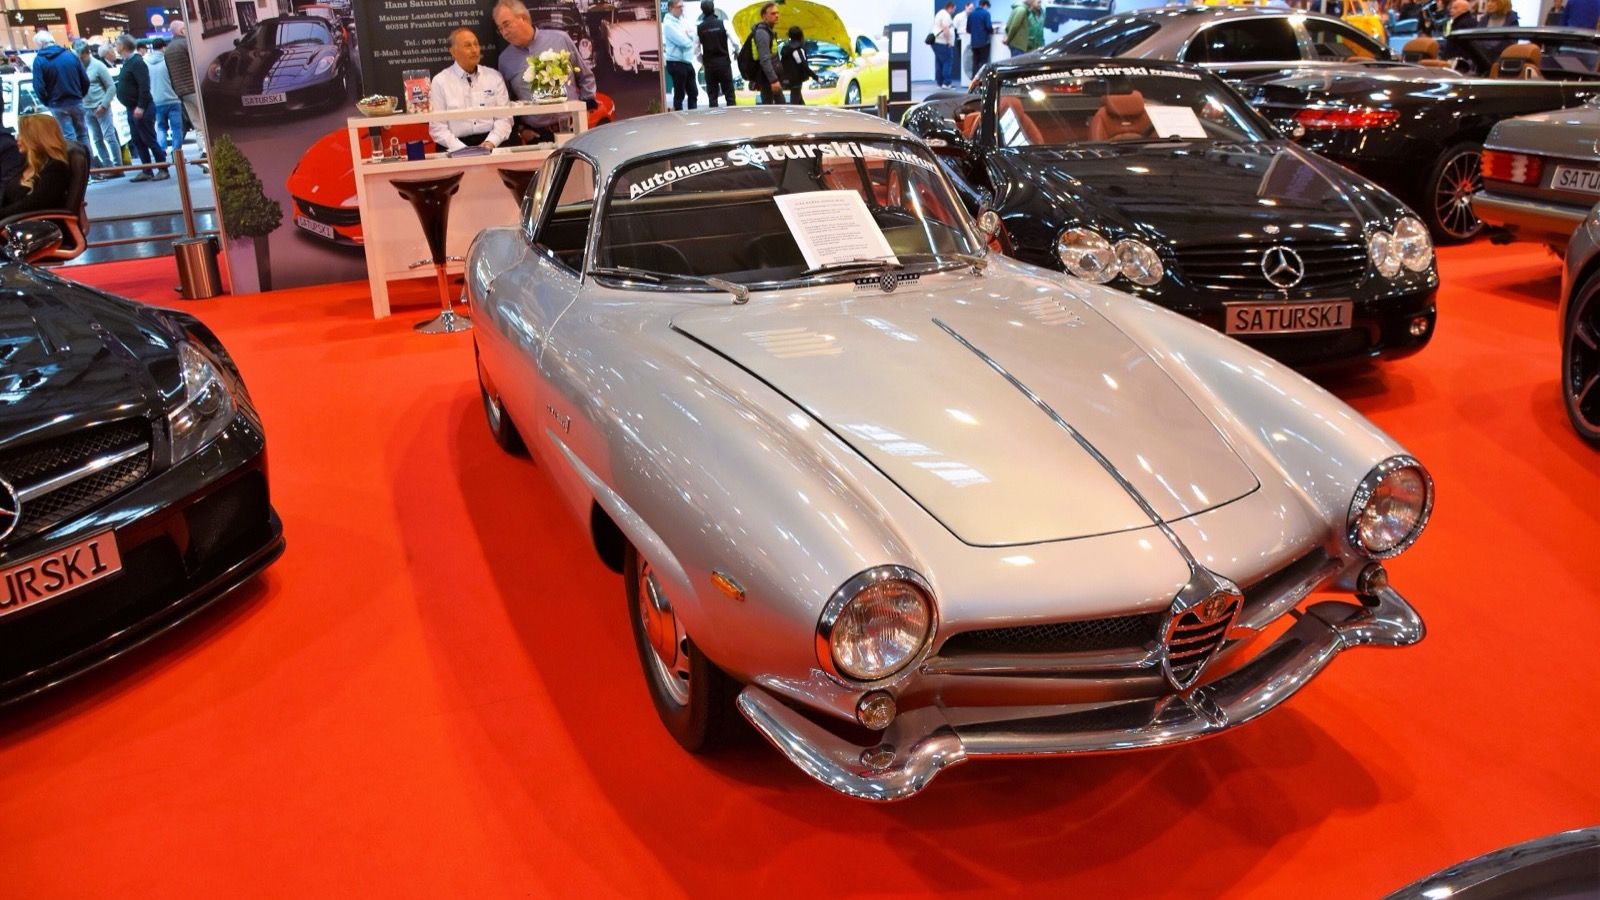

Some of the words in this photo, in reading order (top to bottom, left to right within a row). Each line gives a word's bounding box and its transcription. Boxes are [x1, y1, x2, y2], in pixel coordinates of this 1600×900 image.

[385, 1, 408, 9] Hans
[410, 0, 447, 8] Saturski
[379, 14, 408, 22] Mainzer
[410, 20, 446, 29] Frankfurt
[1016, 71, 1072, 86] Autohaus
[1072, 67, 1148, 77] Saturski
[630, 156, 725, 199] Autohaus
[727, 141, 863, 167] Saturski
[1235, 305, 1343, 331] SATURSKI
